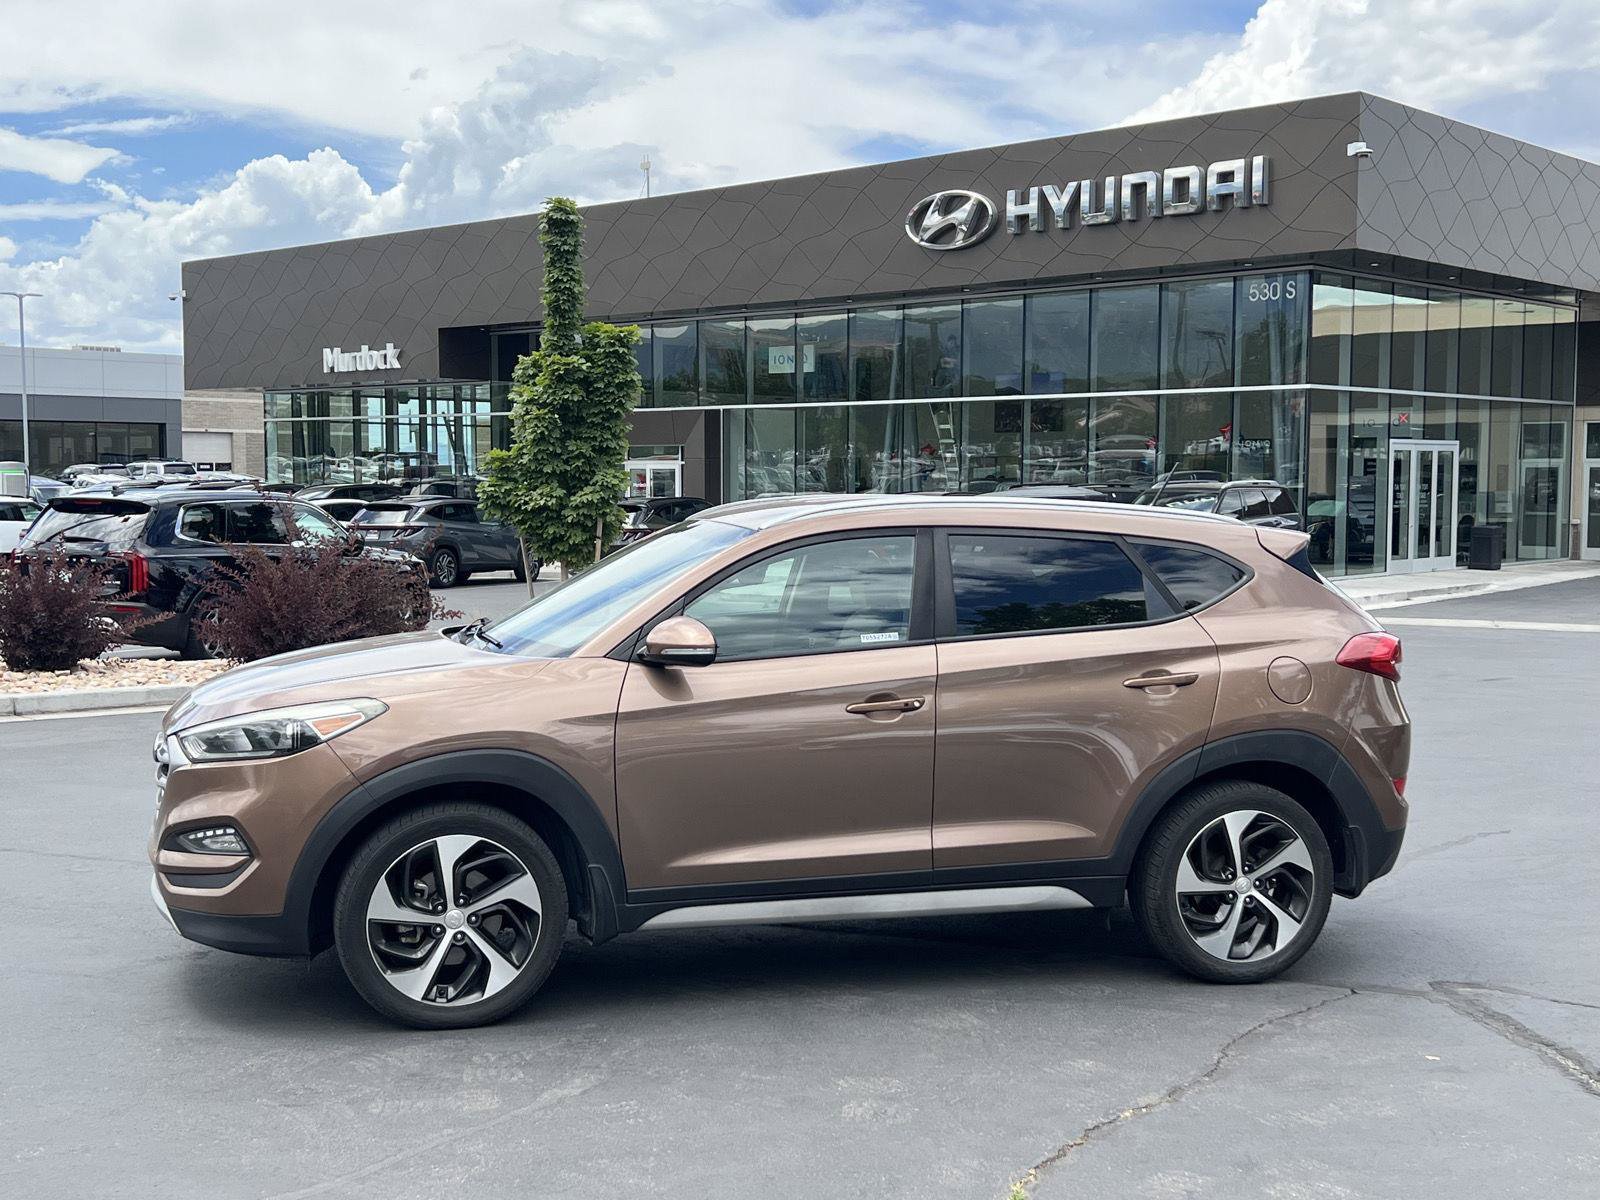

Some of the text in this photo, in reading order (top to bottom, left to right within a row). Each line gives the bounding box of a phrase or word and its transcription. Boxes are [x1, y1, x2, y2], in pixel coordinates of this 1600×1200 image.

[1006, 155, 1268, 234] HYUNDAI
[1249, 280, 1296, 302] 530 S
[322, 342, 401, 373] Murdock
